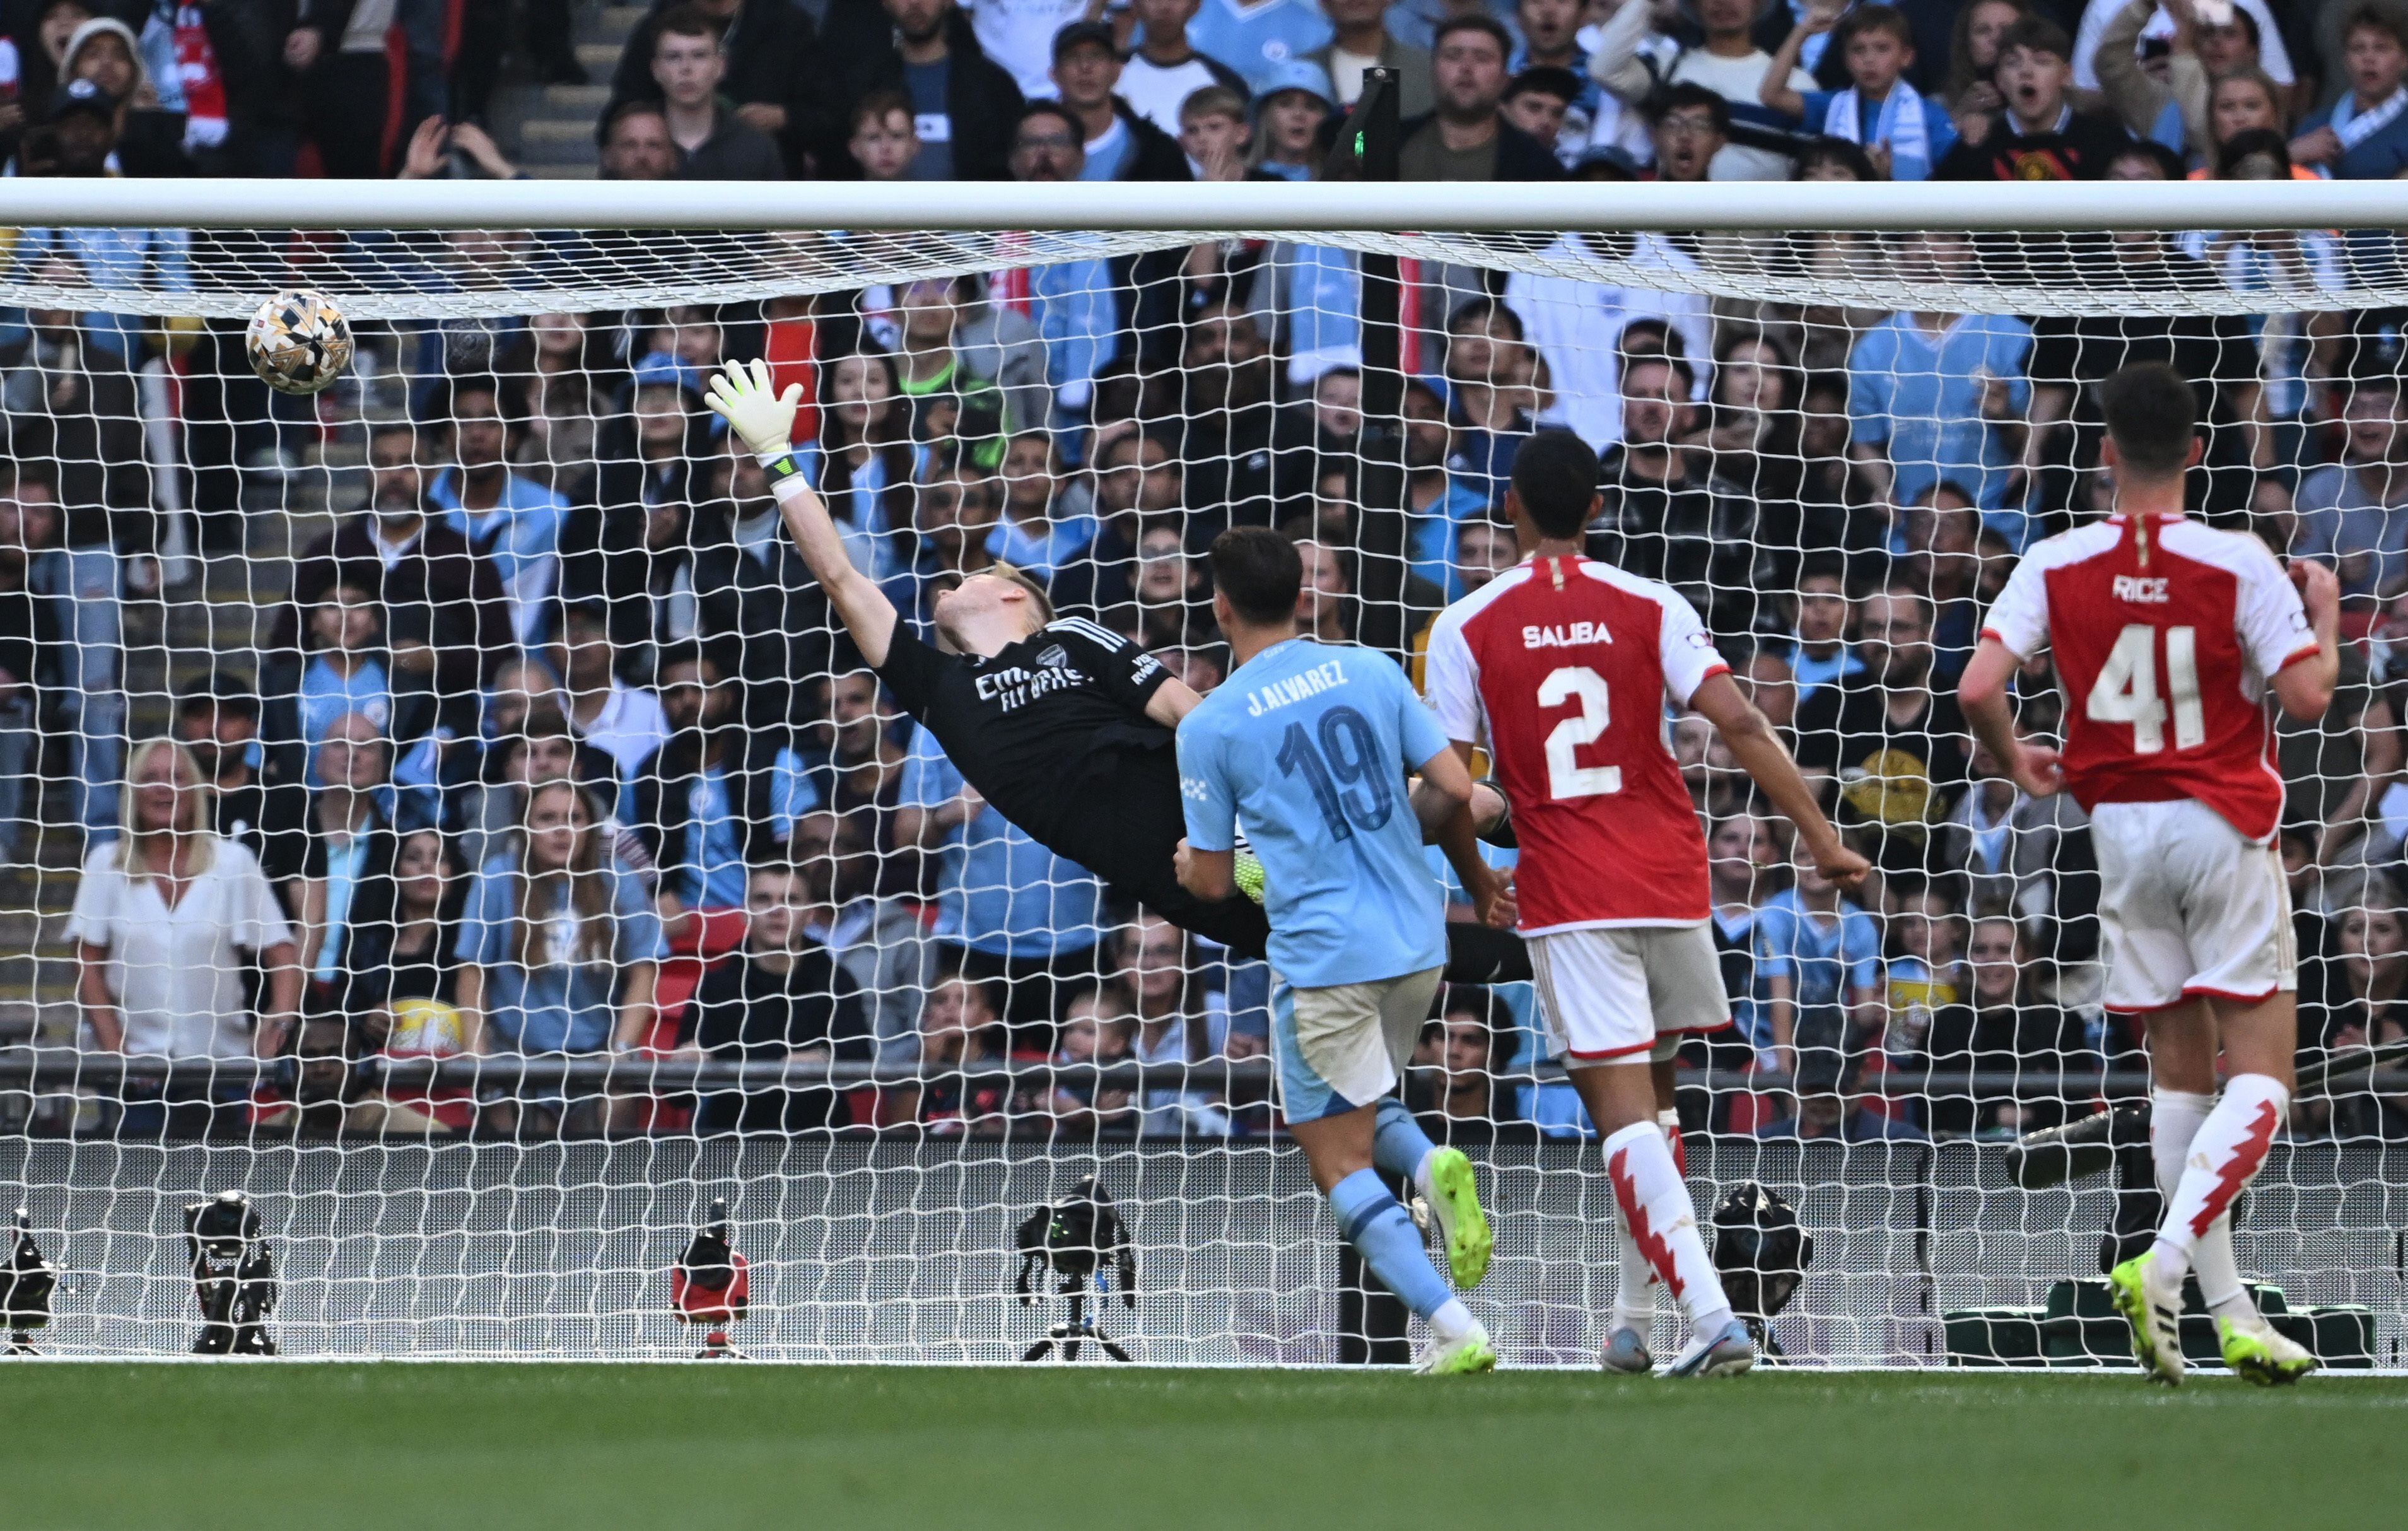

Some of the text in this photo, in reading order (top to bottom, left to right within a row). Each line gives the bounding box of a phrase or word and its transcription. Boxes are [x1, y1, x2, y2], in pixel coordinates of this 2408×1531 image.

[2113, 574, 2170, 604] RICE
[1522, 621, 1613, 648] SALIBA
[1000, 684, 1026, 713] FLY
[1248, 660, 1348, 717] J.ALVAREZ
[2086, 624, 2205, 755] 41
[1537, 666, 1622, 800] 2
[1275, 705, 1392, 843] 19
